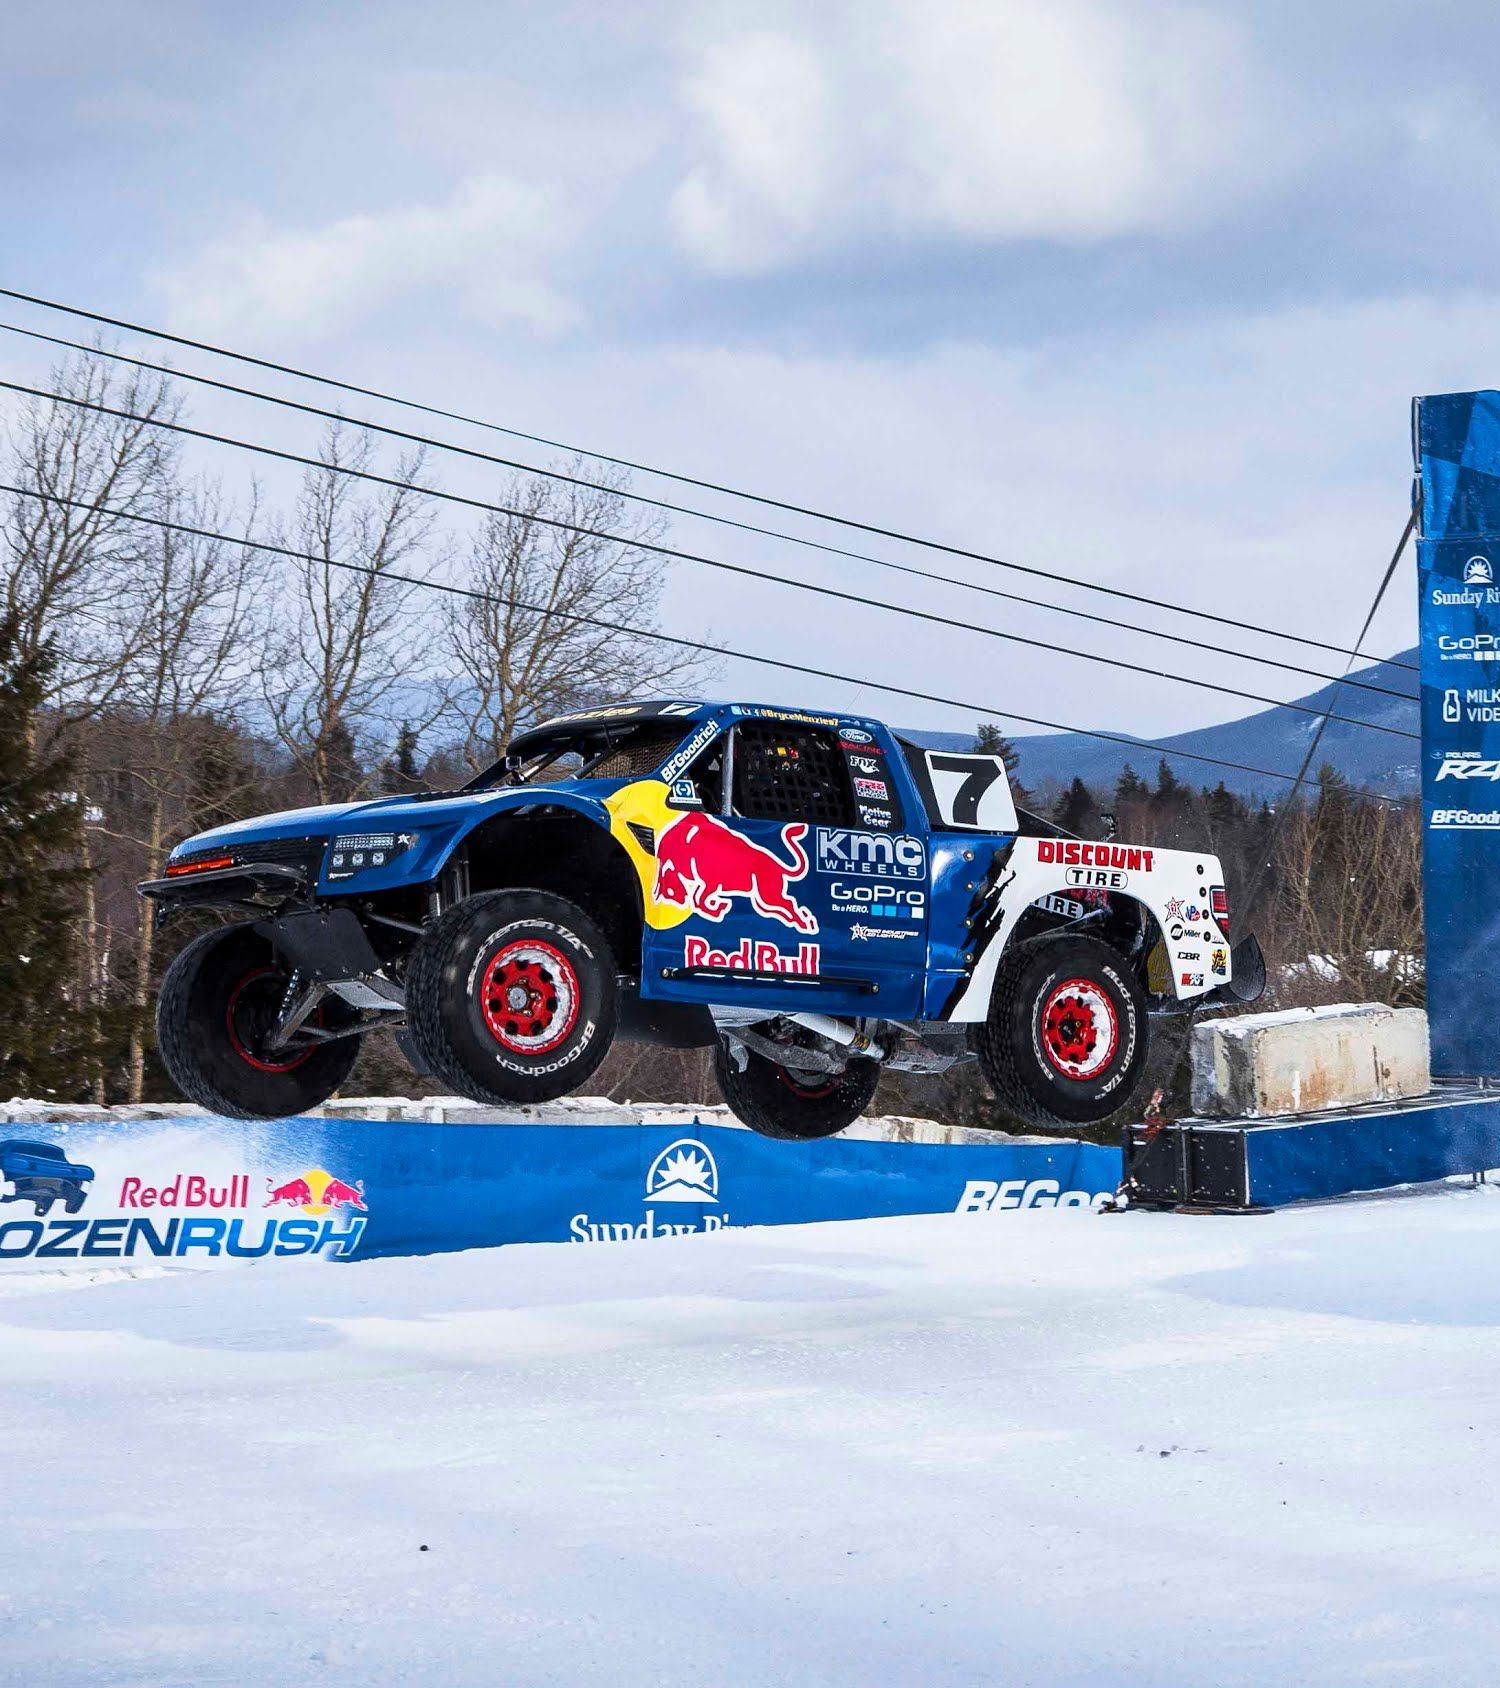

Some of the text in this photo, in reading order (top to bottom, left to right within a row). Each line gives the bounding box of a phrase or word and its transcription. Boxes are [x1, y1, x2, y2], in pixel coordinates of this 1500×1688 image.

[1432, 587, 1483, 608] Sunday
[660, 718, 720, 783] BFGoodrich
[850, 755, 880, 774] FOX
[928, 754, 1003, 826] 7
[858, 804, 892, 819] Motive
[863, 814, 891, 829] Gear
[1037, 840, 1154, 873] DISCOUNT
[824, 858, 919, 877] WHEELS
[1071, 869, 1123, 888] TIRE
[830, 882, 925, 905] GoPro
[1184, 928, 1201, 938] Miller
[685, 934, 752, 972] Red
[1177, 951, 1201, 961] CBR
[496, 1020, 596, 1077] BFGoodrich
[119, 1174, 250, 1209] Red Bull
